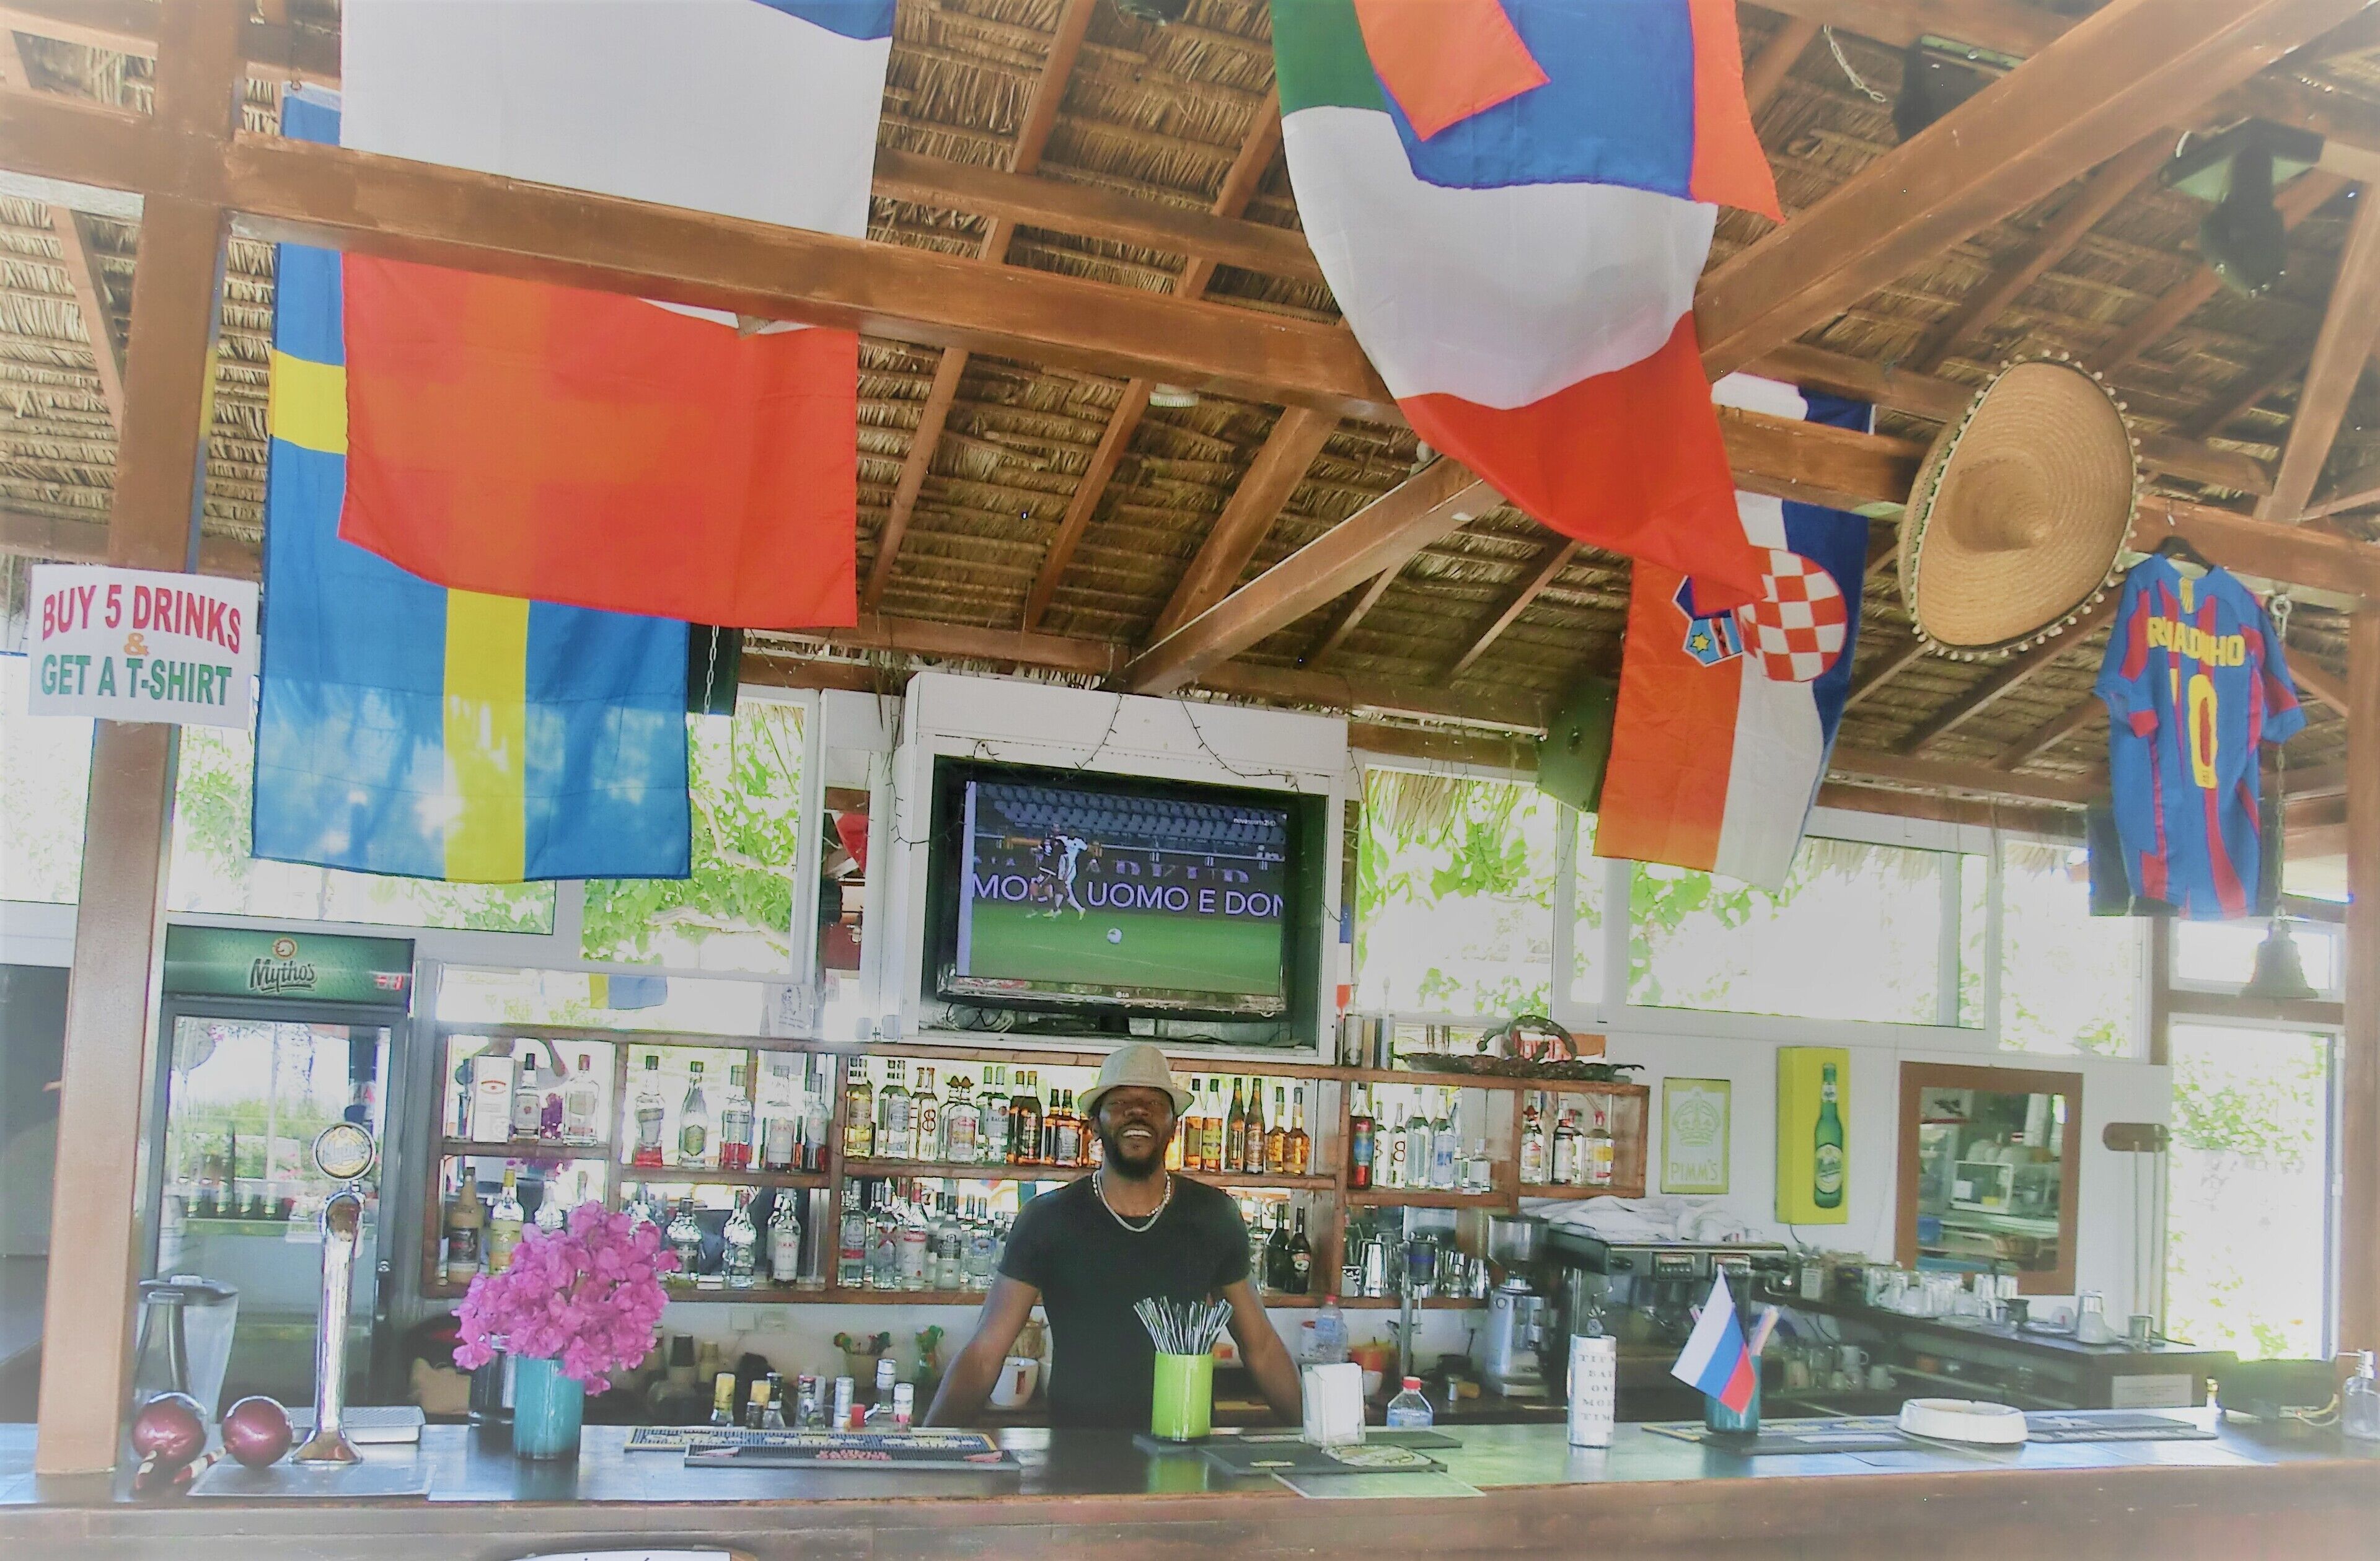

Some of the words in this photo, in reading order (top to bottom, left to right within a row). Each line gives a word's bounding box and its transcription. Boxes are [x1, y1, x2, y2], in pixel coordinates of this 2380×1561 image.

[42, 584, 97, 642] BUY
[105, 584, 123, 629] 5
[133, 585, 241, 654] DRINKS
[123, 633, 149, 657] &
[41, 654, 91, 695] GET
[97, 656, 117, 697] A
[126, 657, 232, 706] T-SHIRT
[1086, 880, 1189, 912] UOMO
[1199, 889, 1216, 913] E
